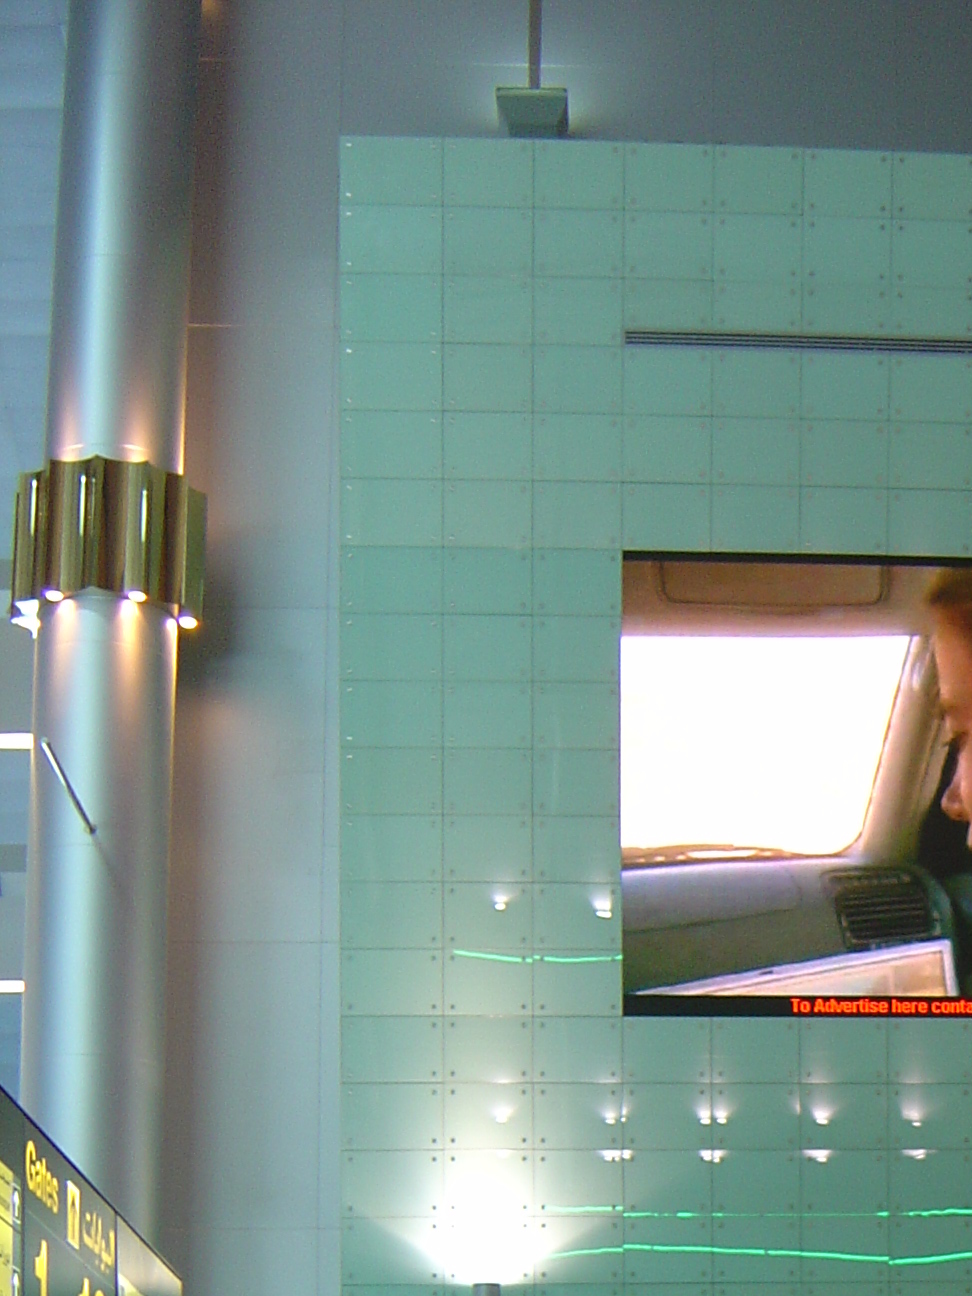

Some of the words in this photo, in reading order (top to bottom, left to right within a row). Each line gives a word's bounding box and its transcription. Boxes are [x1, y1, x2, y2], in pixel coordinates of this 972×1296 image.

[790, 999, 811, 1014] To
[813, 999, 889, 1014] Advertise
[891, 999, 928, 1014] here
[25, 1140, 59, 1214] Gates
